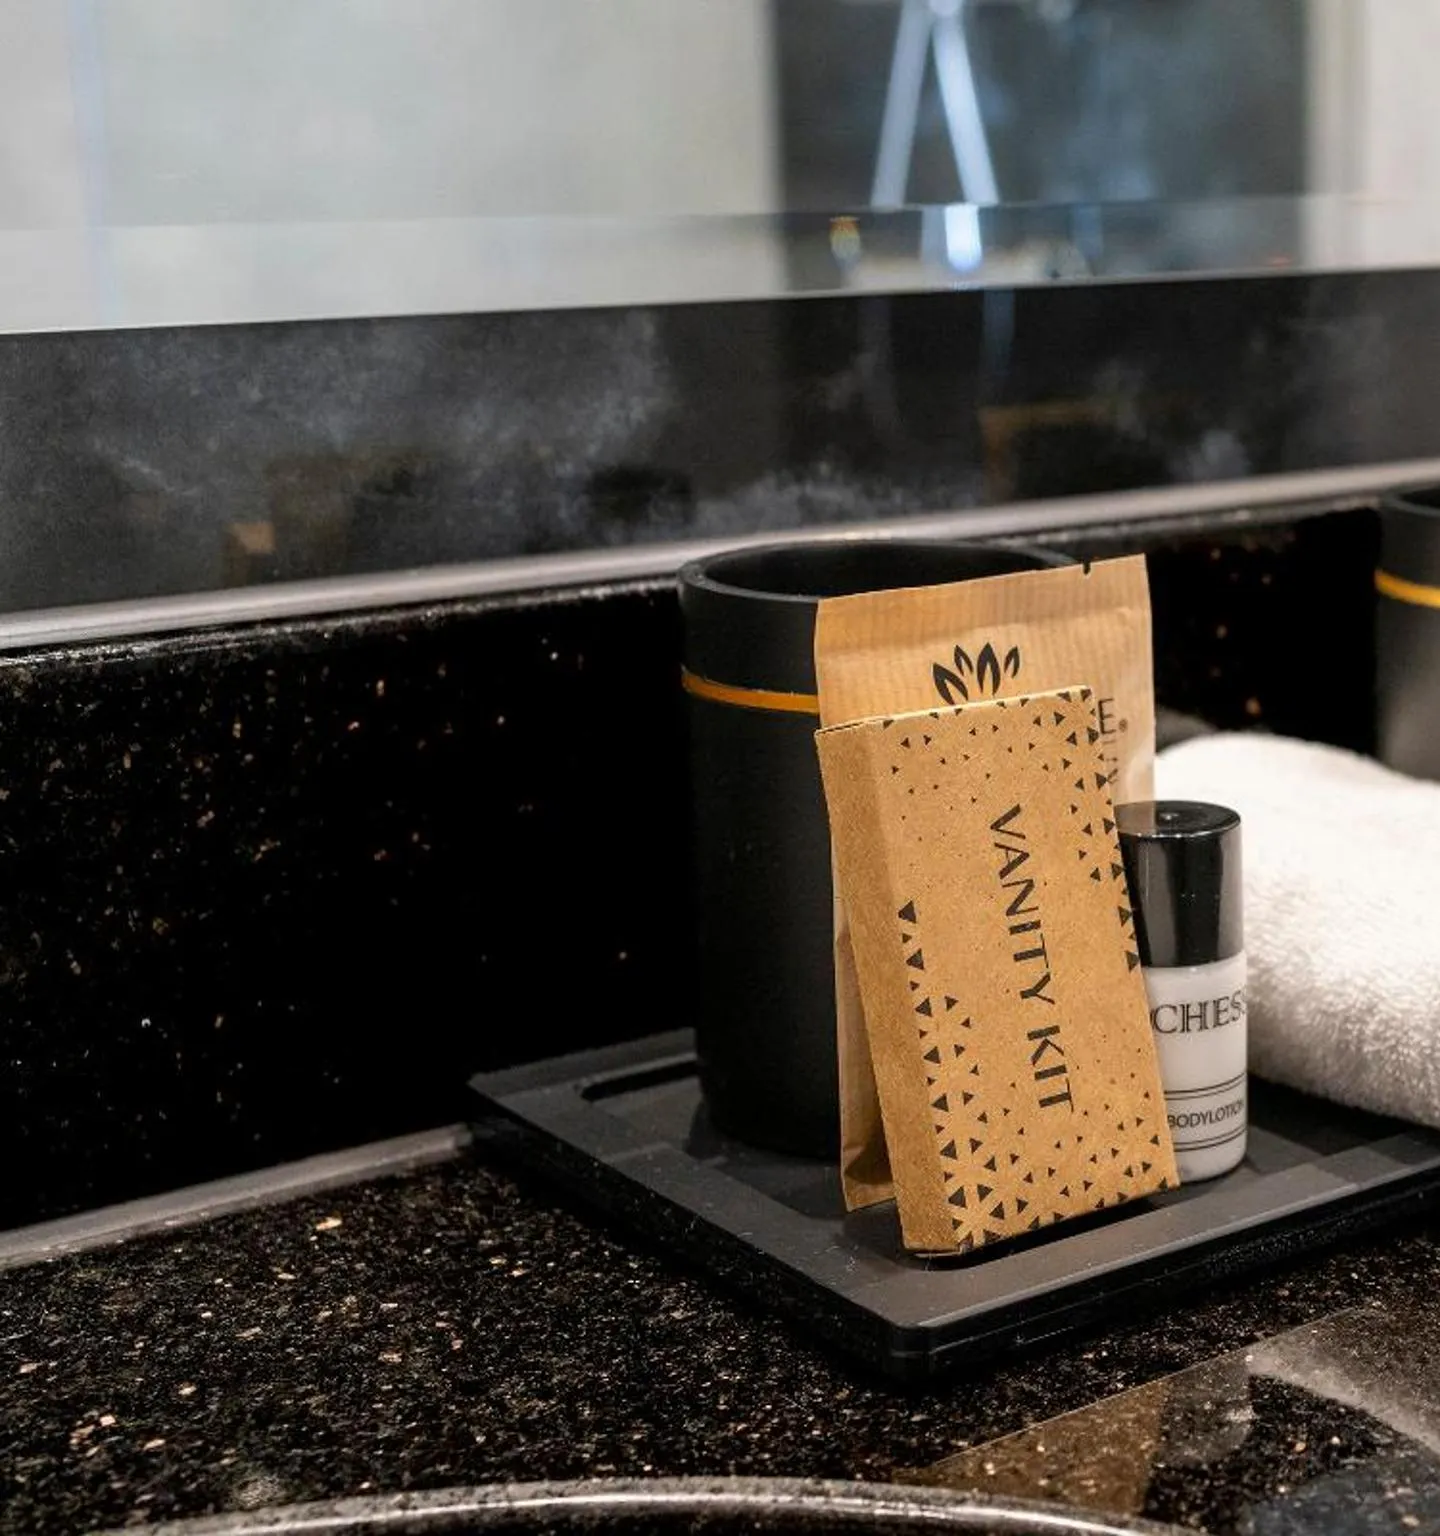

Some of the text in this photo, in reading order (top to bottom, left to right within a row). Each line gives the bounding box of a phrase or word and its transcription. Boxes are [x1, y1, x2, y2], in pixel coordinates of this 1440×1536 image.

[990, 803, 1074, 1114] VANITY KIT
[1149, 989, 1245, 1034] CHES
